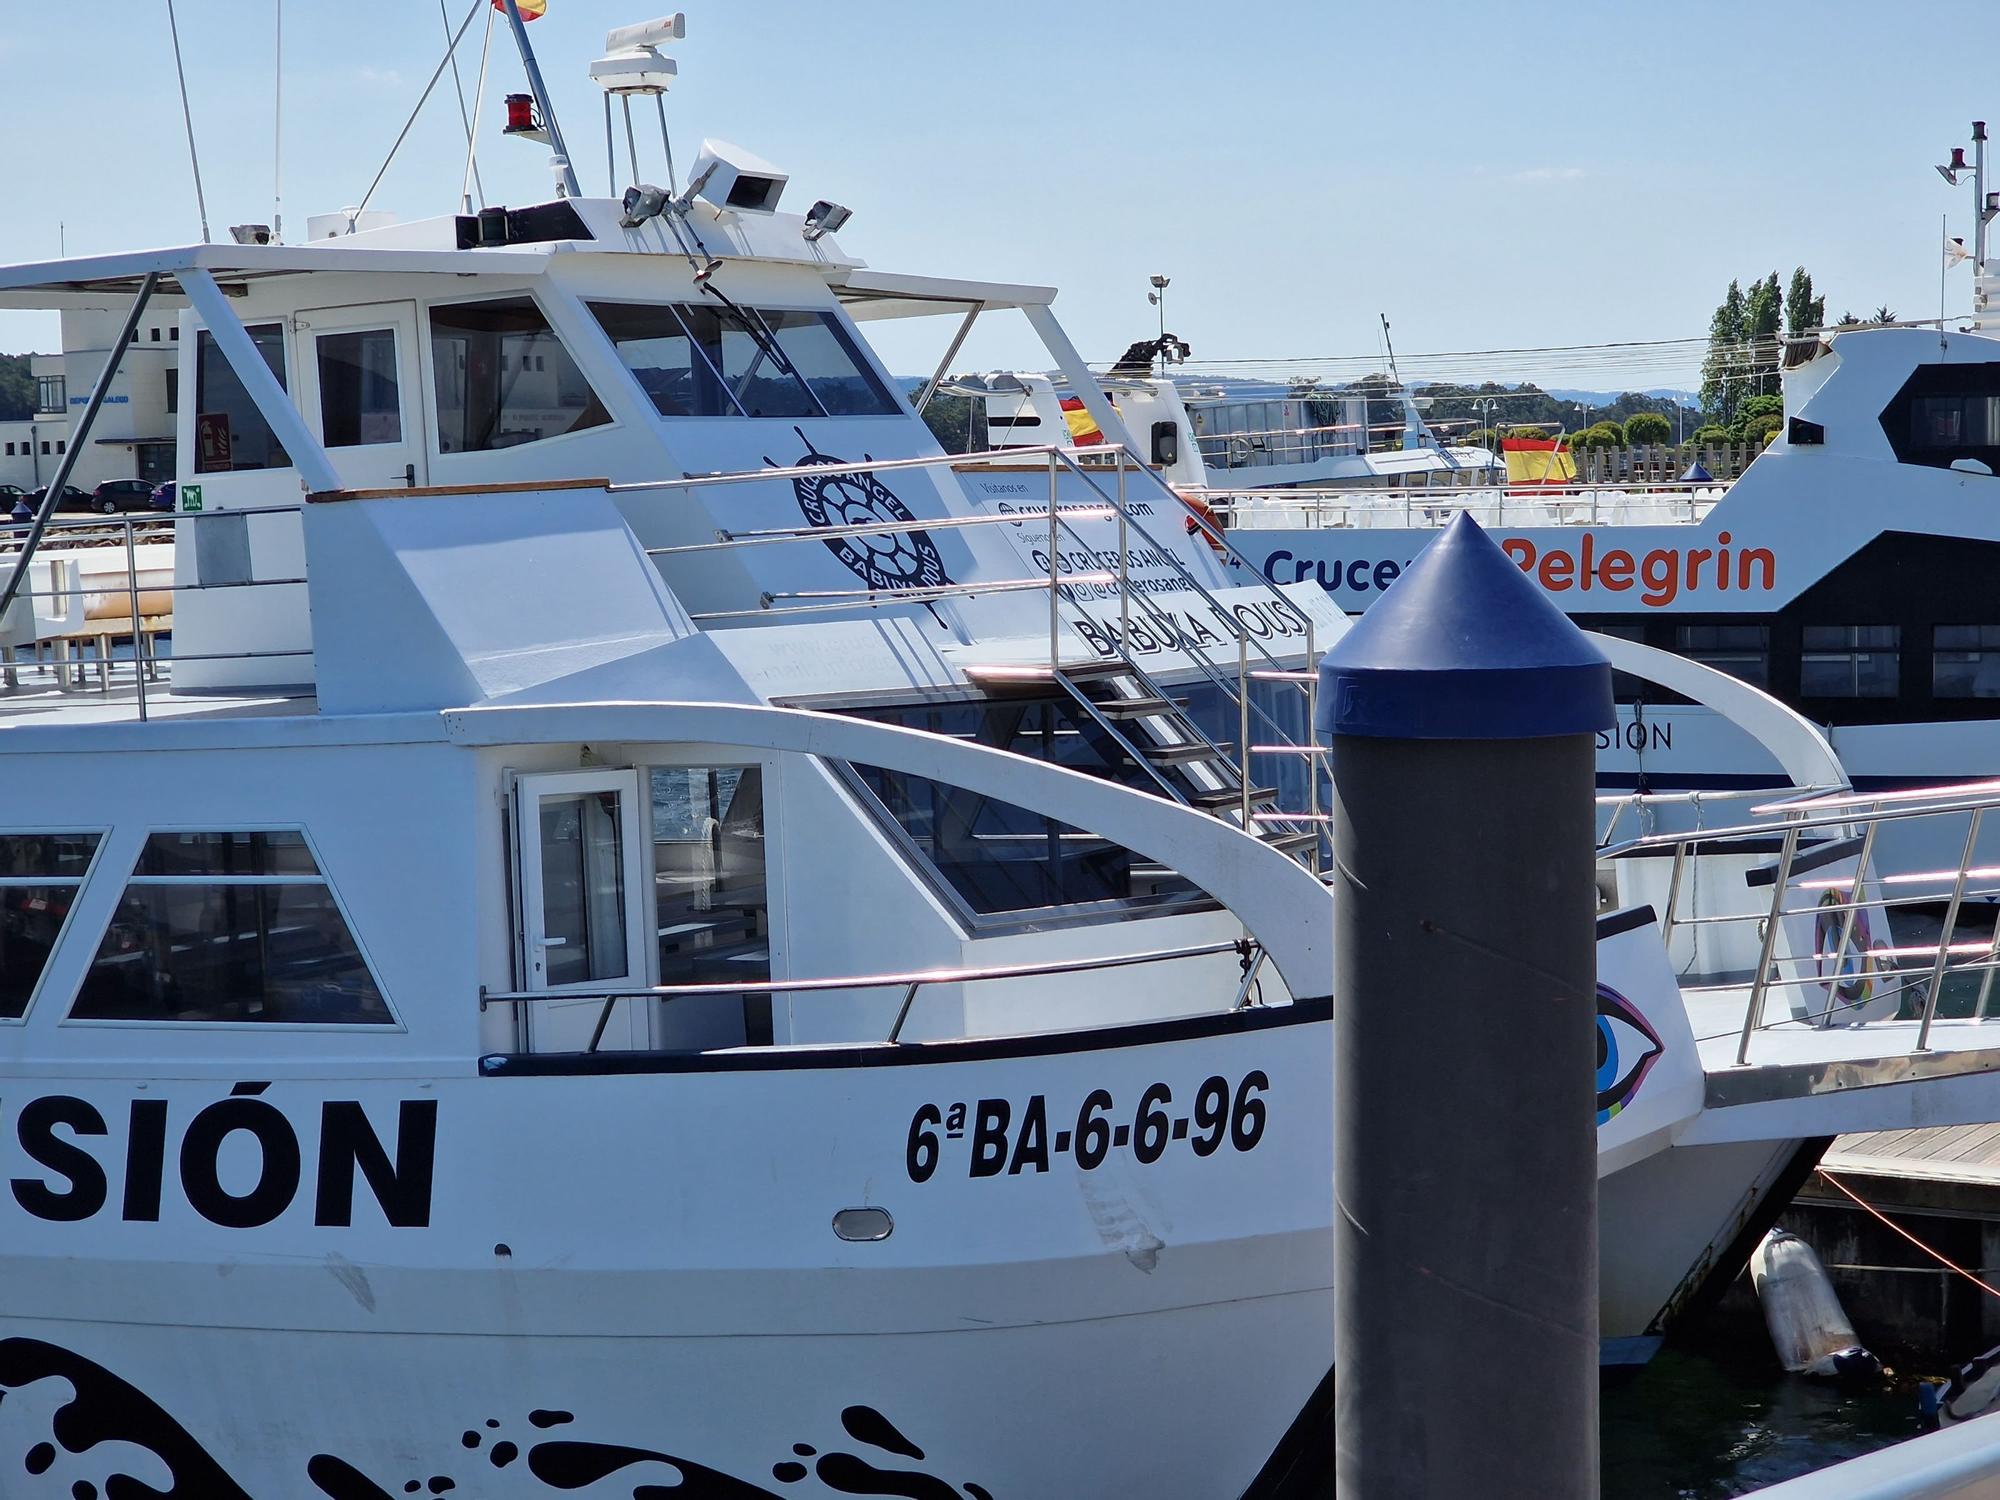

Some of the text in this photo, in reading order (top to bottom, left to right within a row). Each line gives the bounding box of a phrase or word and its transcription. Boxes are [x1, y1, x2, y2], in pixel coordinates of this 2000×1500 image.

[846, 473, 905, 520] ANGEL
[1138, 547, 1186, 568] ANL
[1264, 531, 1775, 607] Cruce Pelegrin
[1089, 571, 1195, 599] @crerosang
[1596, 721, 1672, 750] SION
[0, 1081, 439, 1229] SIÓN
